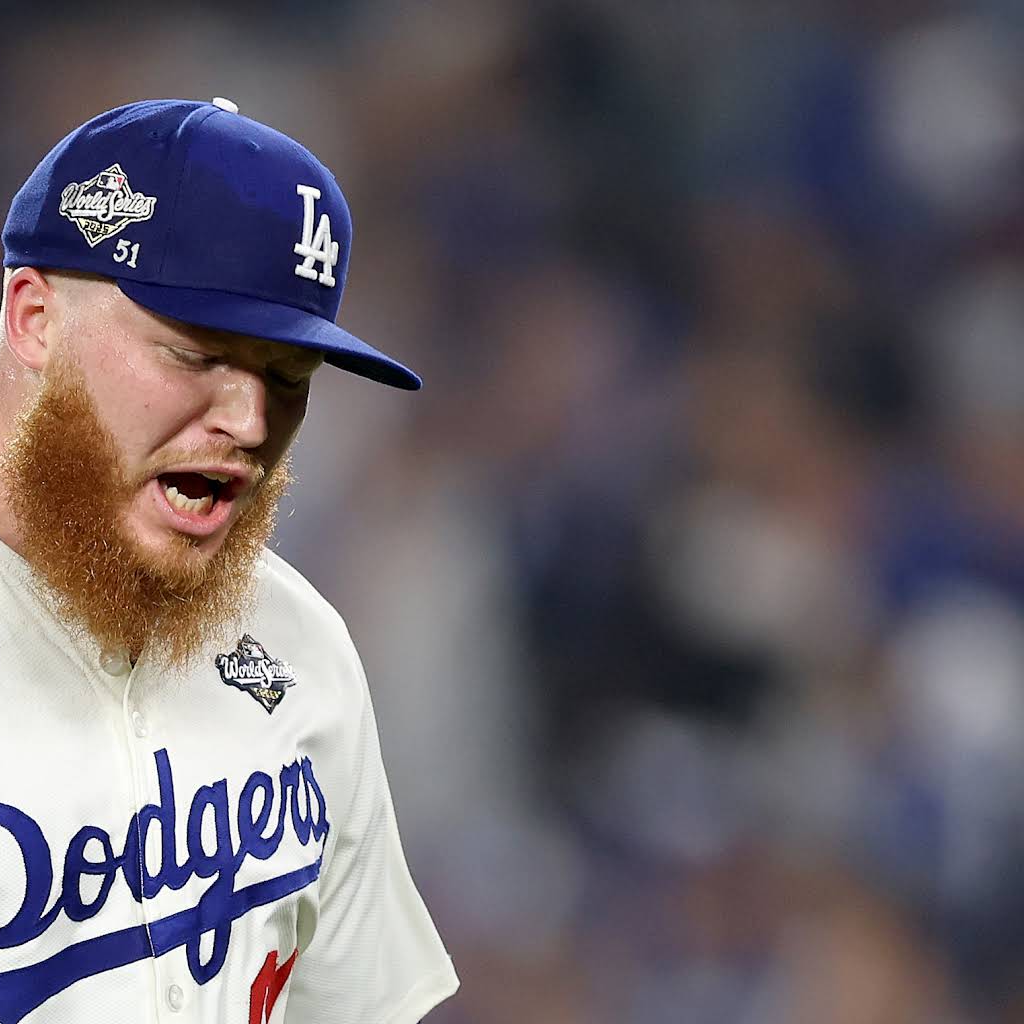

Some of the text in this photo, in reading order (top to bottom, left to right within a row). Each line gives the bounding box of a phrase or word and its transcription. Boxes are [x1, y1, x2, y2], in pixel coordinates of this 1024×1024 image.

[60, 183, 153, 221] World Series
[294, 184, 339, 287] LA
[113, 238, 140, 268] 51
[219, 656, 264, 680] World
